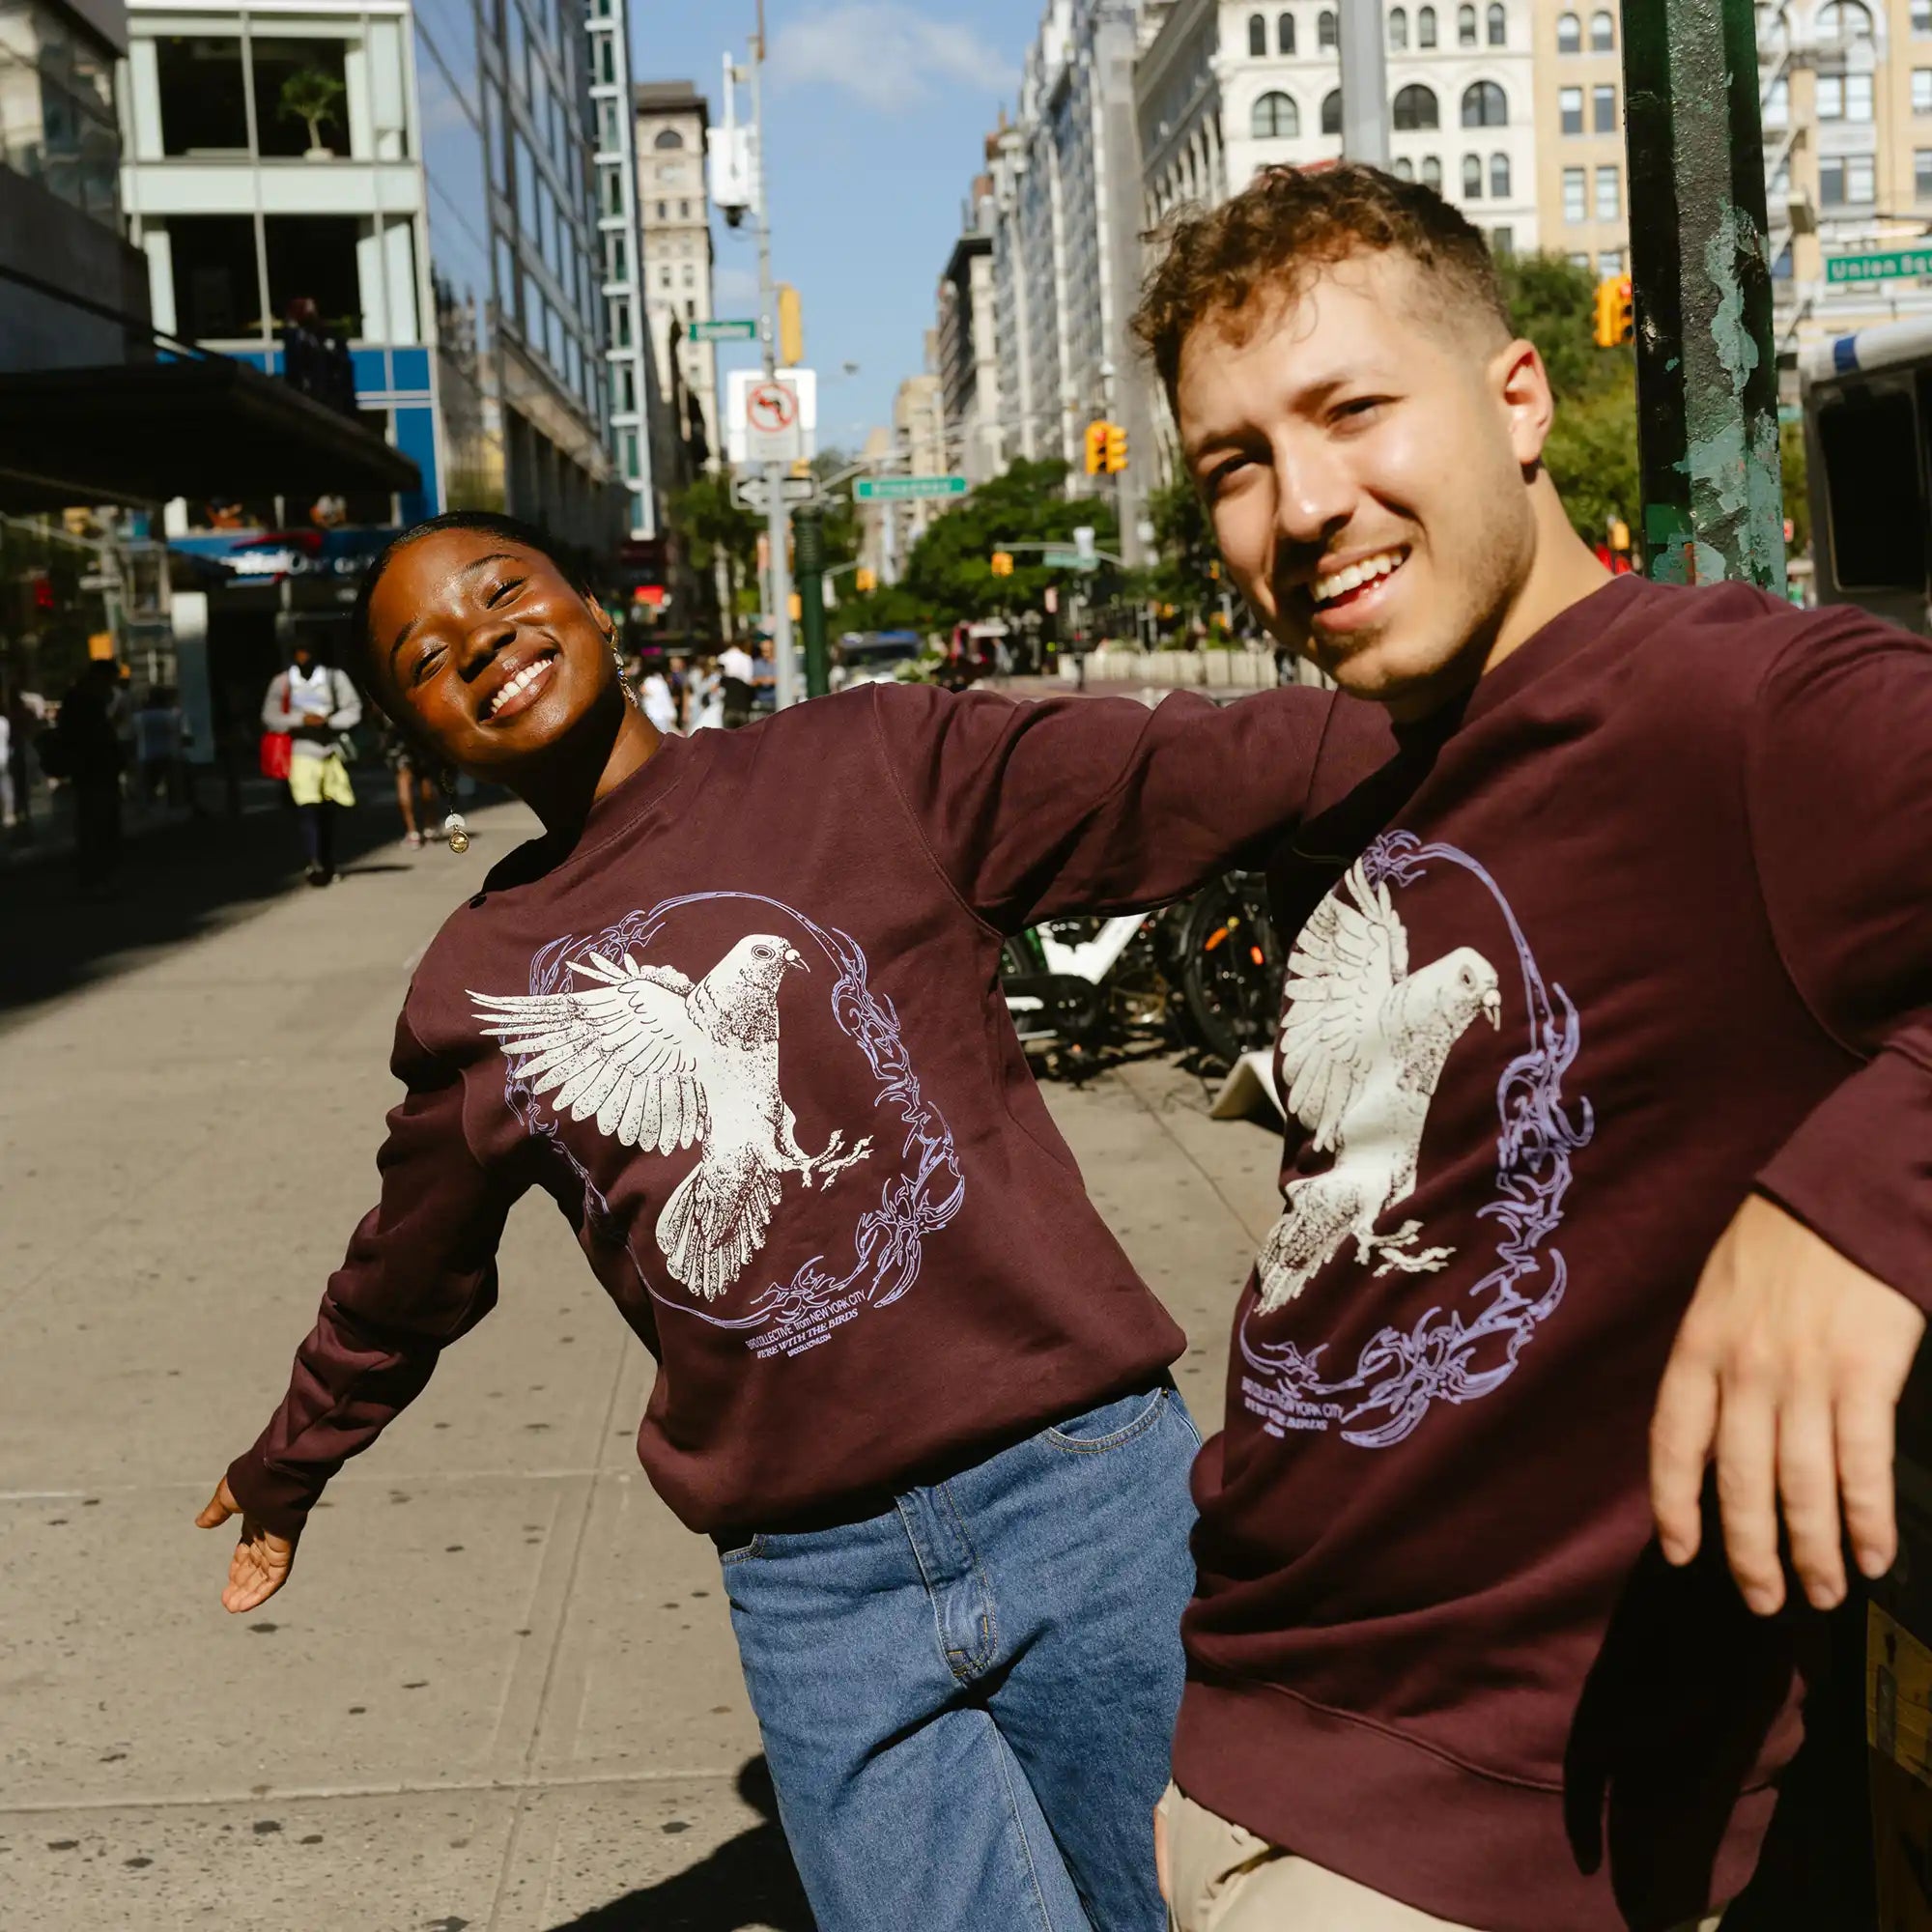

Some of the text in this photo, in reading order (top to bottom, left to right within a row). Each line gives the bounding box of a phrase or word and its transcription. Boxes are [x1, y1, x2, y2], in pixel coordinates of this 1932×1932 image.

[1832, 260, 1896, 279] Union
[810, 1306, 830, 1323] NEW
[827, 1297, 850, 1315] YORK
[849, 1289, 867, 1305] CITY
[778, 1332, 807, 1350] WITH
[807, 1322, 828, 1338] THE
[828, 1309, 859, 1329] BIRDS
